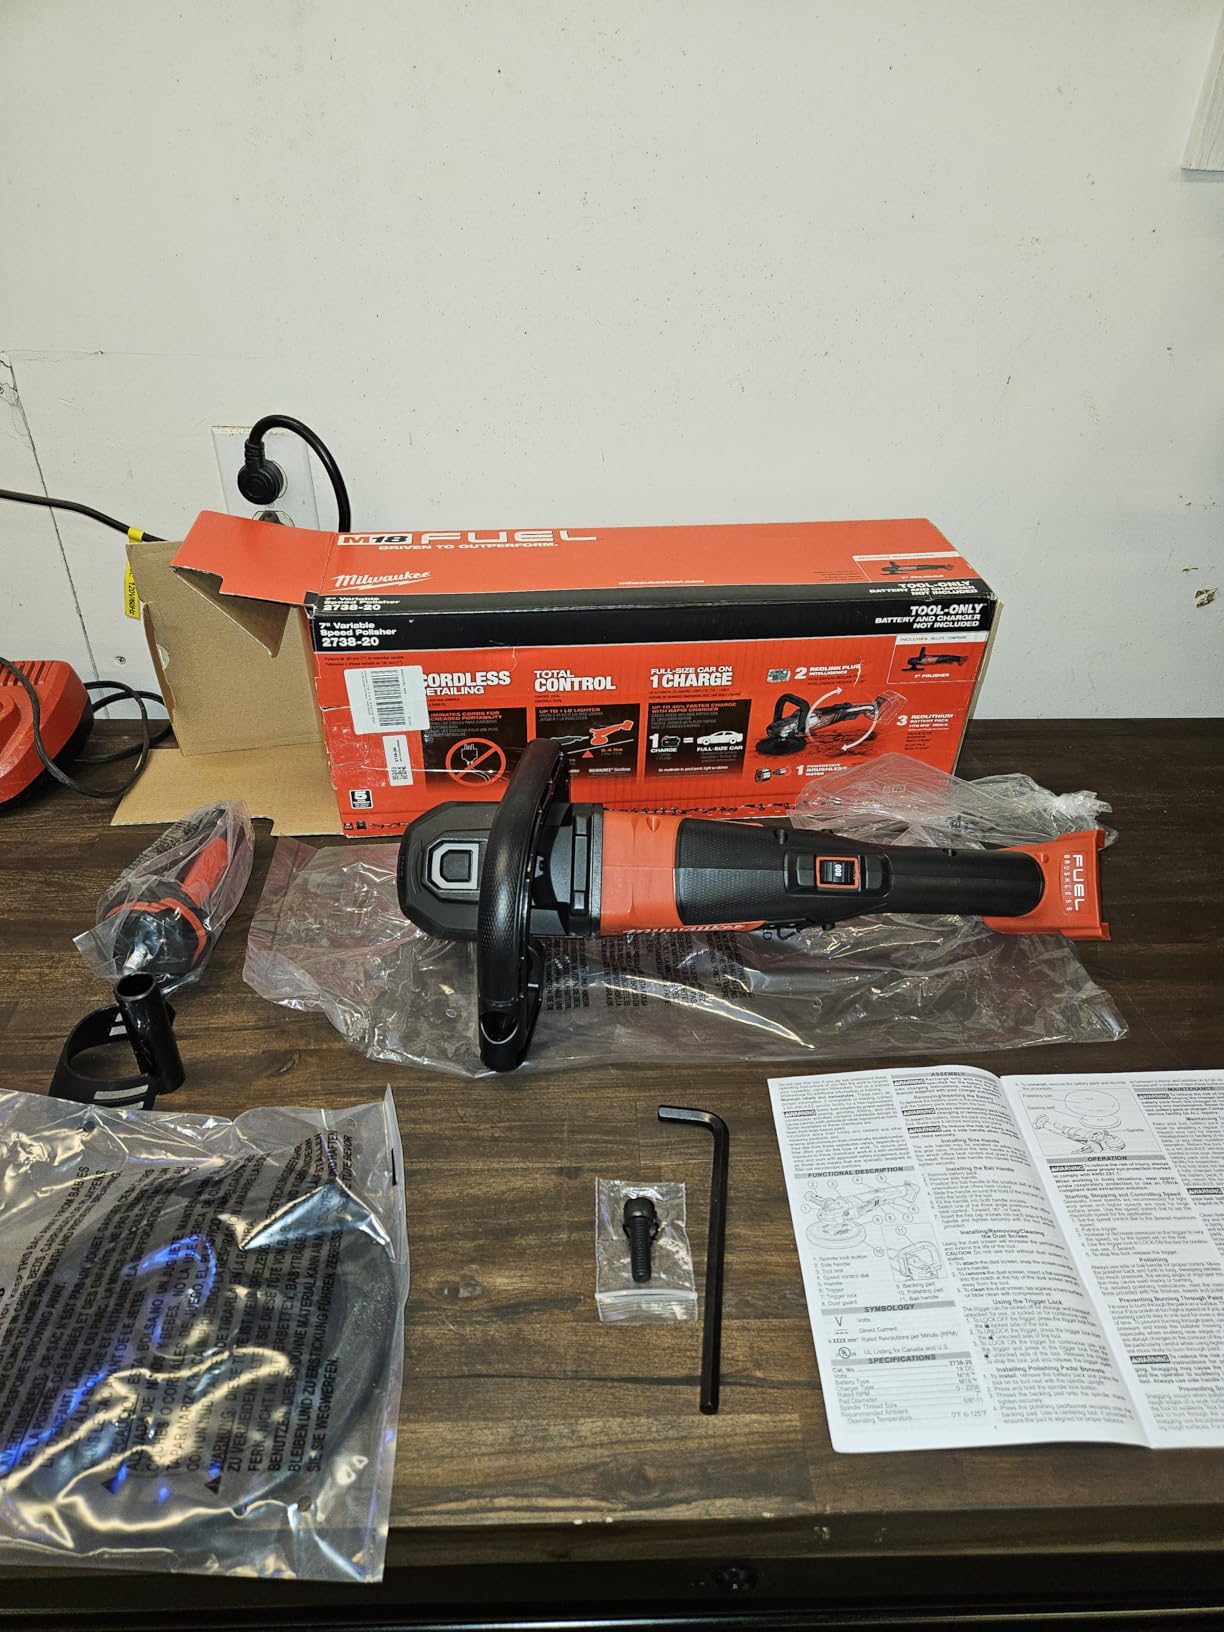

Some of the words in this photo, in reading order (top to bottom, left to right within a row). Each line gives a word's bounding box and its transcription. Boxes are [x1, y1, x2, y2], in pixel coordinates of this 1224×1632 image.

[341, 535, 409, 545] M18
[419, 529, 597, 545] FUEL
[330, 571, 432, 591] Milwaukee
[898, 580, 971, 589] TOOL-ONLY
[128, 581, 136, 617] 120V/60Hz
[323, 603, 381, 611] 2738-20
[910, 603, 984, 616] TOOL-ONLY
[875, 616, 915, 624] BATTERY
[320, 629, 353, 637] Speed
[322, 636, 379, 647] 2738-20
[534, 670, 575, 679] TOTAL
[650, 667, 695, 675] FULL-SIZE
[794, 667, 807, 680] 2
[534, 676, 616, 692] CONTROL
[650, 674, 659, 688] 1
[661, 672, 733, 688] CHARGE
[425, 685, 484, 696] ETAILING
[896, 715, 908, 726] 3
[649, 733, 659, 748] 1
[796, 765, 805, 776] 1
[1063, 853, 1073, 912] BRUSHLESS
[1072, 853, 1086, 912] FUEL
[327, 1130, 338, 1161] HAFTEN
[342, 1134, 353, 1162] BEVOR
[341, 1162, 352, 1182] TÜTE
[808, 1170, 854, 1178] FUNCTIONAL
[855, 1166, 904, 1175] DESCRIPTION
[17, 1249, 33, 1272] THIS
[67, 1163, 91, 1199] BABIES
[27, 1251, 47, 1278] BEDS,
[177, 1264, 192, 1281] LA
[172, 1281, 186, 1296] NO
[136, 1313, 157, 1351] BOLSA
[148, 1298, 163, 1314] NO
[156, 1278, 170, 1292] UN
[864, 1304, 915, 1313] SYMBOLOGY
[835, 1316, 843, 1327] V
[256, 1323, 270, 1339] SIE
[116, 1334, 130, 1349] DE
[213, 1332, 228, 1349] DE
[305, 1313, 329, 1379] ERSTICKUNG
[868, 1354, 937, 1364] SPECIFICATIONS
[1136, 1355, 1170, 1364] WARNING
[264, 1383, 277, 1395] IN
[303, 1380, 316, 1396] ZU
[313, 1356, 339, 1431] WEGWERFEN.
[140, 1396, 154, 1412] DE
[299, 1397, 313, 1422] UND
[230, 1388, 257, 1454] VERMEIDEN
[288, 1423, 309, 1472] BLEIBEN
[311, 1433, 326, 1450] SIE
[229, 1457, 241, 1472] ZU
[308, 1454, 322, 1473] SIE
